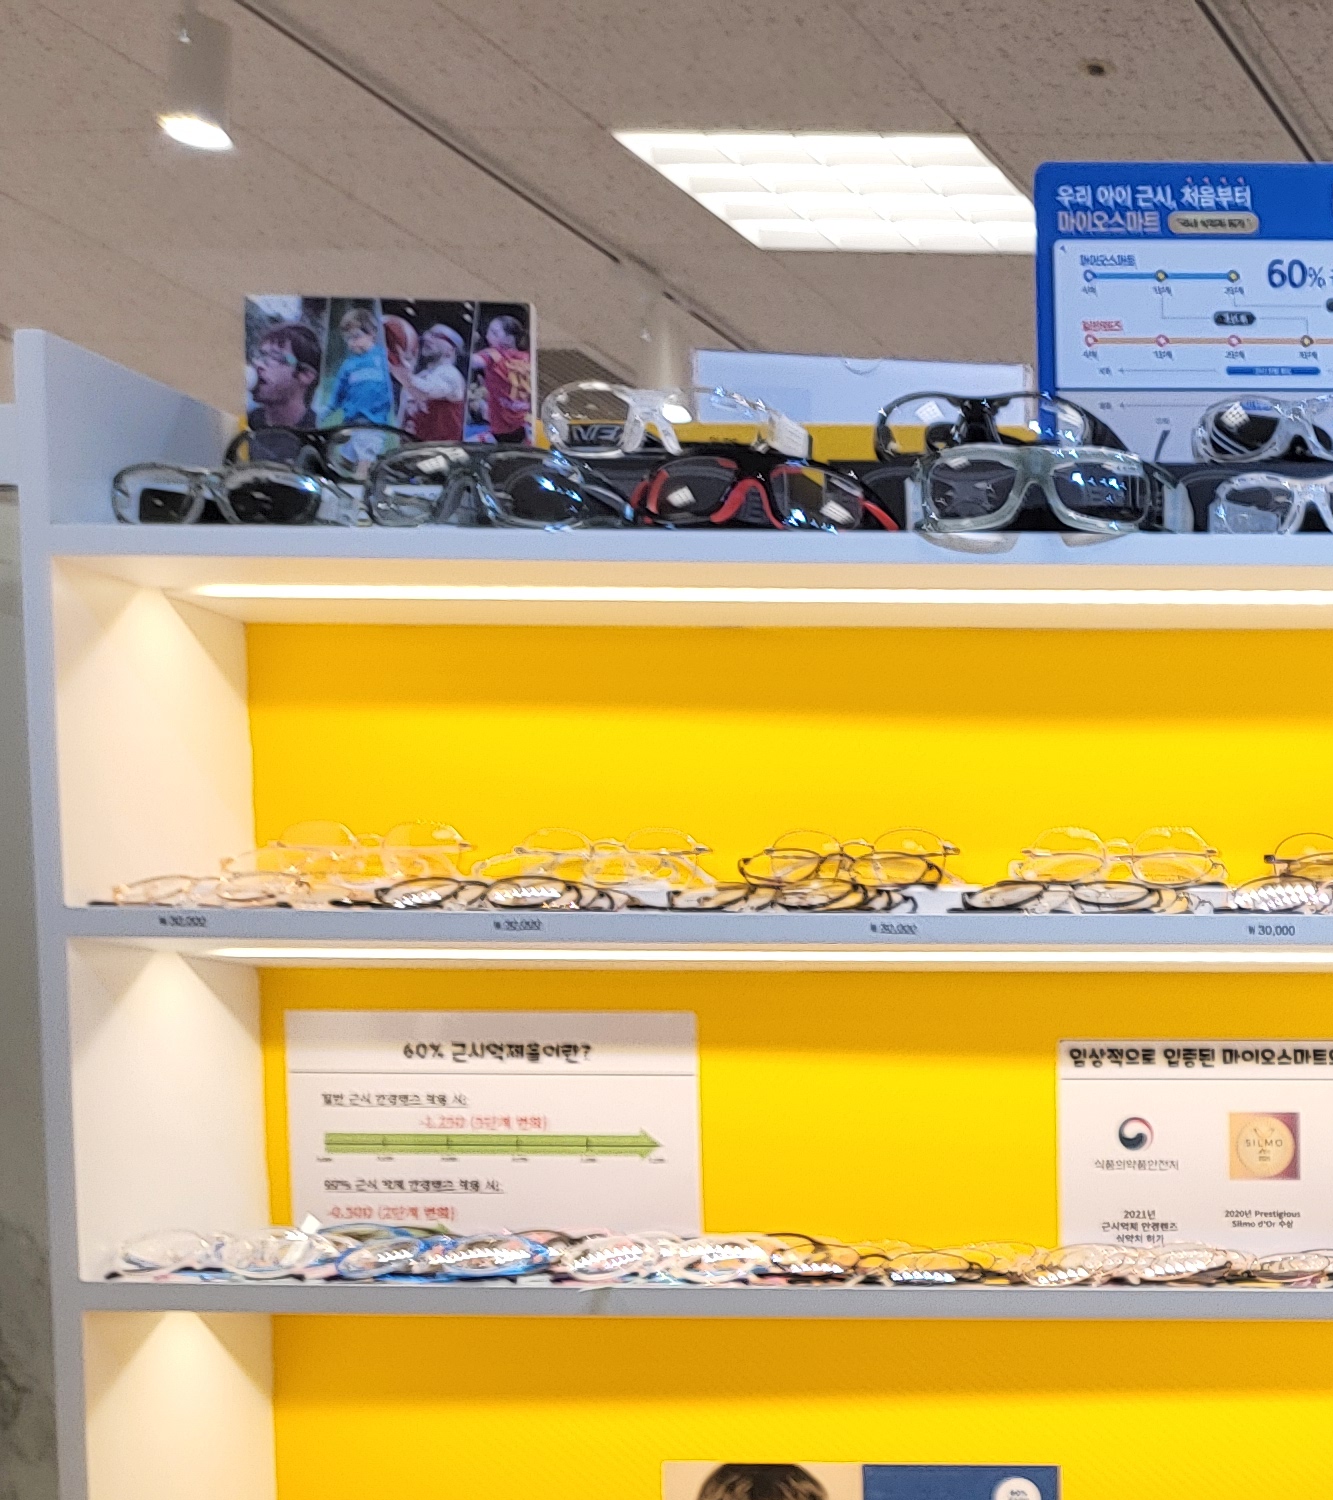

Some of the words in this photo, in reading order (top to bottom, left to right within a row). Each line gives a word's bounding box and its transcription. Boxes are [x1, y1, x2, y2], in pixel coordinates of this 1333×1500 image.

[1056, 185, 1092, 209] 우리
[1097, 185, 1131, 209] 아이
[1181, 185, 1252, 210] 처음부터
[1057, 211, 1161, 234] 마이오스마트
[1267, 259, 1326, 289] 60%
[1258, 925, 1296, 936] 30,000
[403, 1041, 444, 1060] 60%
[451, 1040, 592, 1064] 근시억제율이란?
[1069, 1047, 1156, 1068] 임상적으로
[1163, 1047, 1215, 1068] 입증된
[1246, 1139, 1283, 1148] SILMO
[1123, 1210, 1156, 1219] 2021년
[1224, 1210, 1252, 1219] 2020년
[1254, 1210, 1301, 1220] Prestigious
[1232, 1220, 1255, 1228] Silmo
